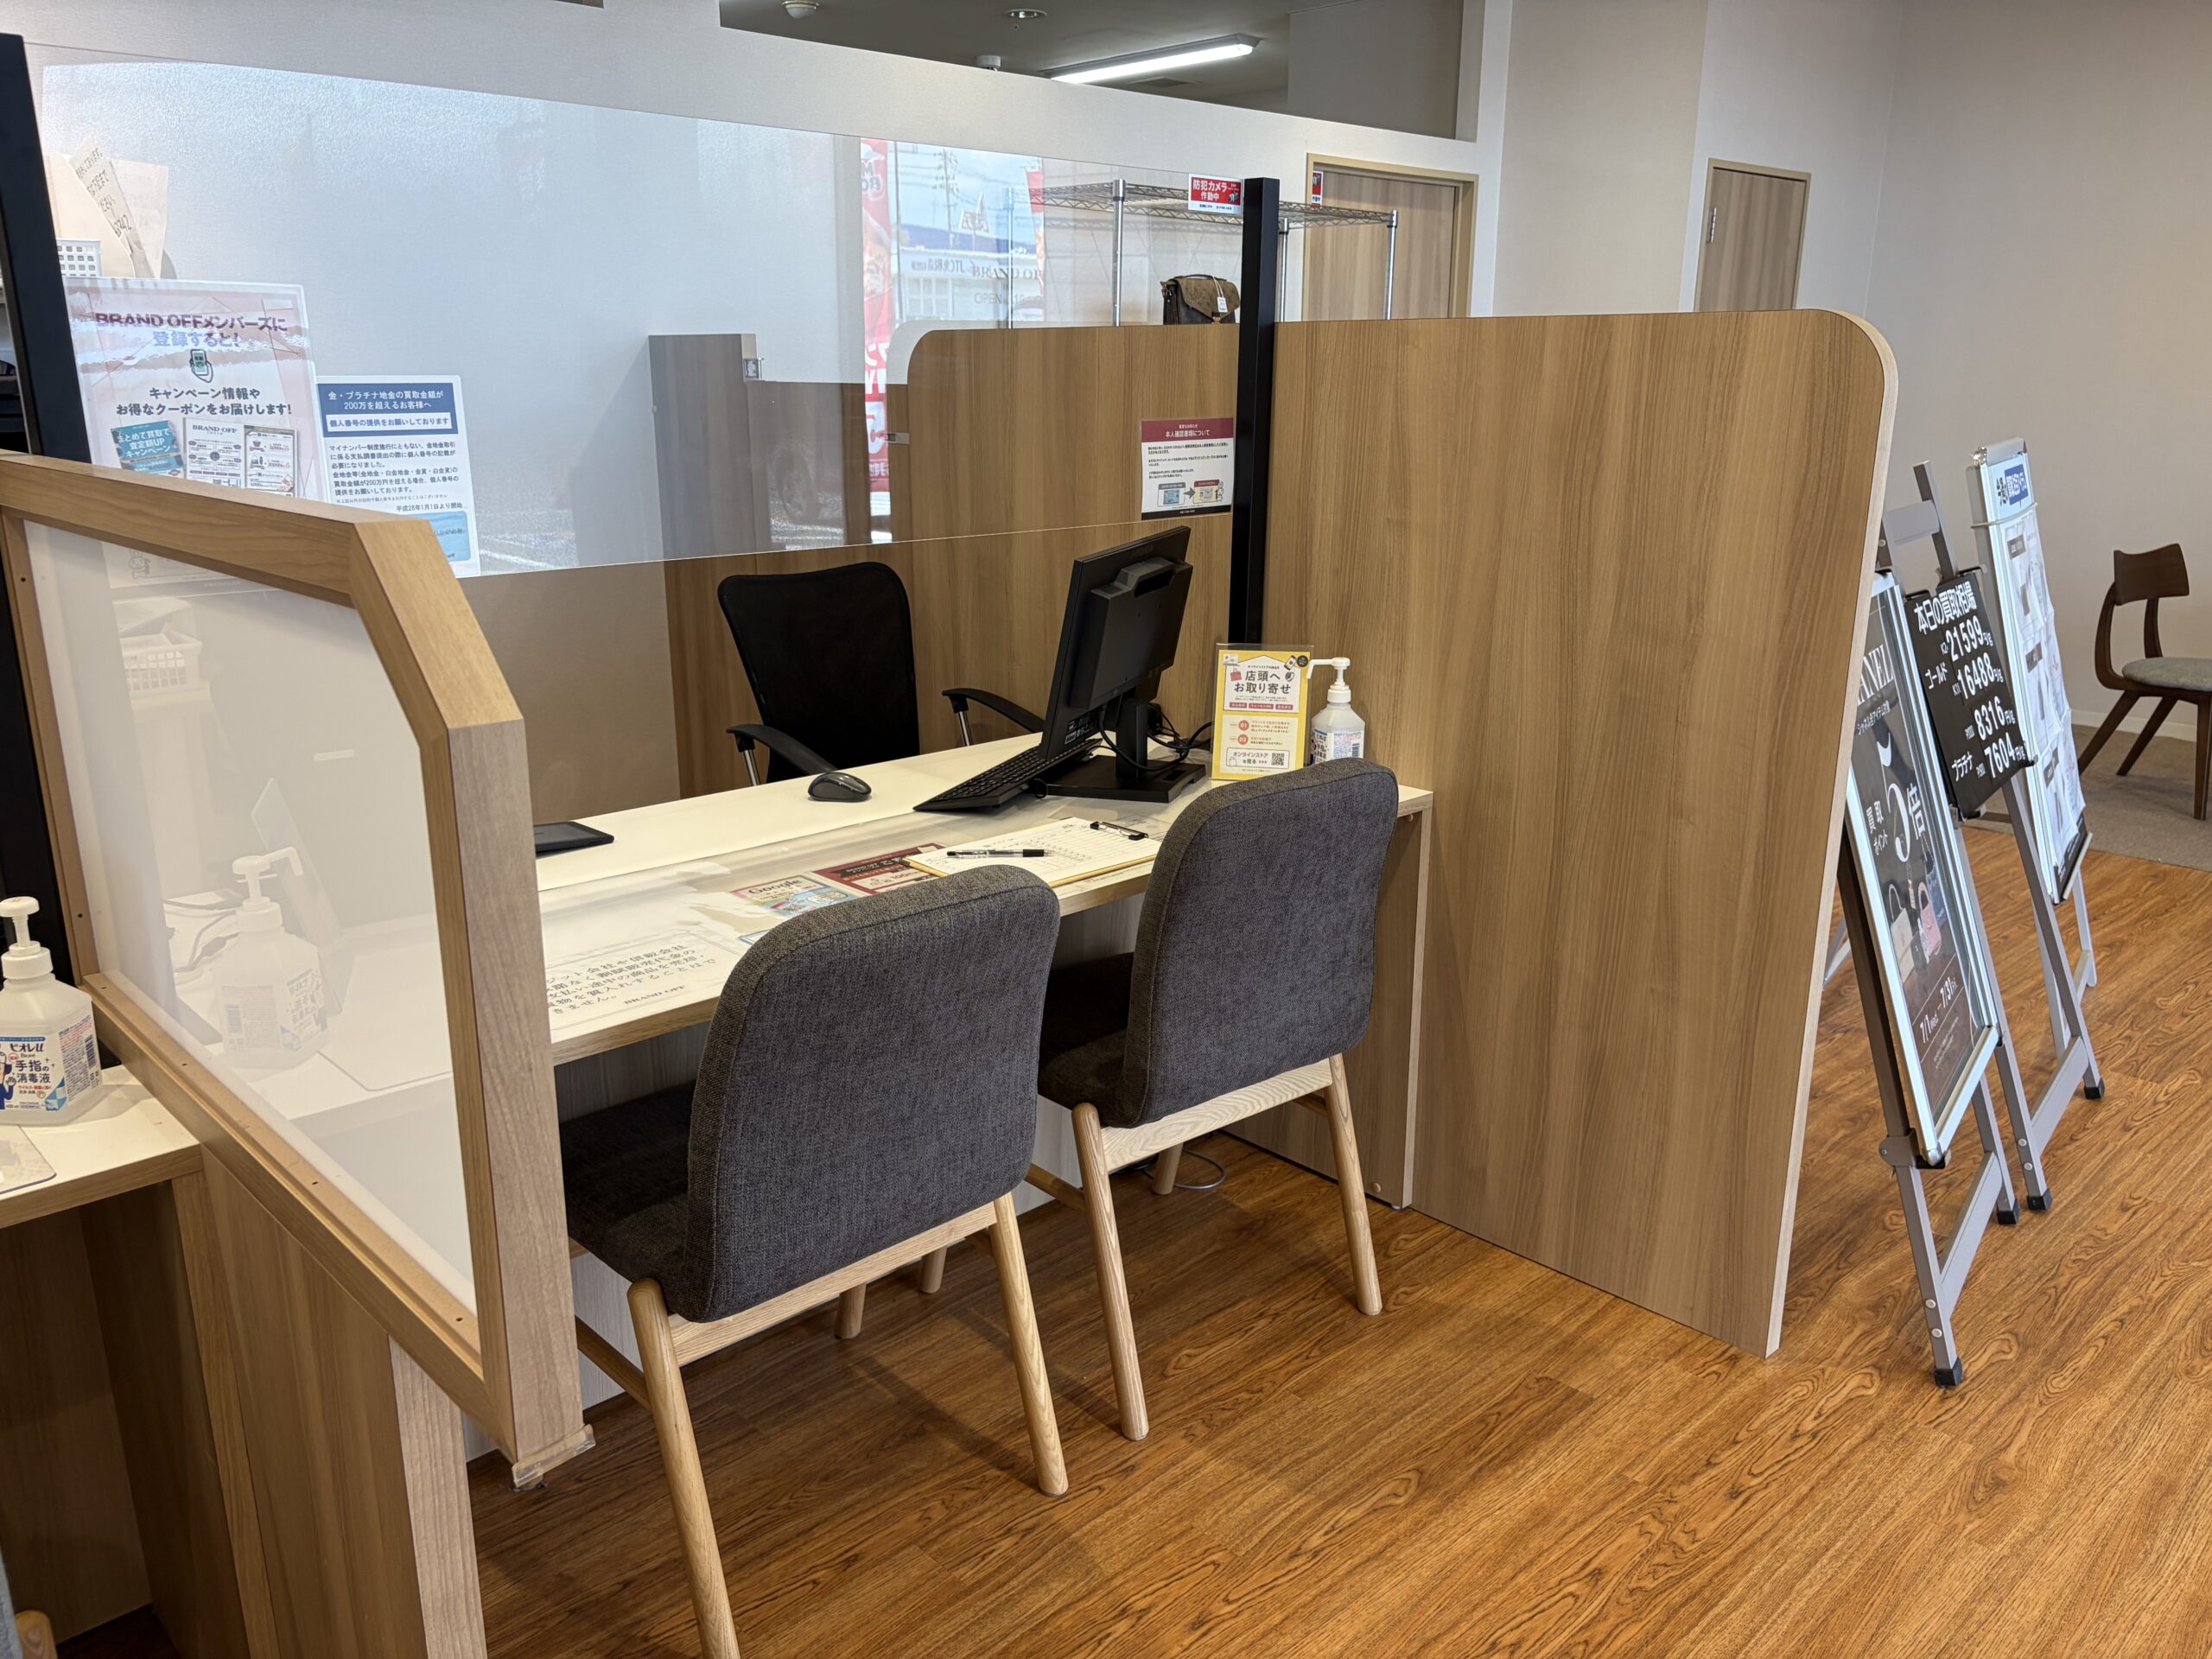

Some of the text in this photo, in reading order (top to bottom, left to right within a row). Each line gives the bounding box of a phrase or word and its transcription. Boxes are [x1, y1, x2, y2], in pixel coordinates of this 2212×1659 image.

[1192, 180, 1227, 193] 防犯カメラ
[1201, 191, 1219, 201] 作動中
[95, 313, 164, 327] BRAND
[149, 387, 260, 400] キャンペーン情報や
[327, 391, 444, 401] 金・プラチナ地金の買取金額が
[116, 403, 292, 416] お得なクーポンをお届けします!
[344, 401, 432, 410] 200万を超えるお客様へ
[329, 417, 449, 428] 個人番号の提供をお願いしております
[125, 446, 171, 458] キャンペーン
[1914, 581, 1978, 635] 本日の買取相場
[1245, 671, 1281, 682] 店頭へ
[1924, 662, 1948, 690] ゴールド
[1234, 682, 1292, 695] お取り寄せ
[1951, 751, 1973, 782] プラチナ
[748, 879, 802, 894] Google
[624, 984, 686, 1004] BRAND OFF
[15, 1059, 49, 1072] 手指の
[17, 1072, 51, 1084] 消毒液
